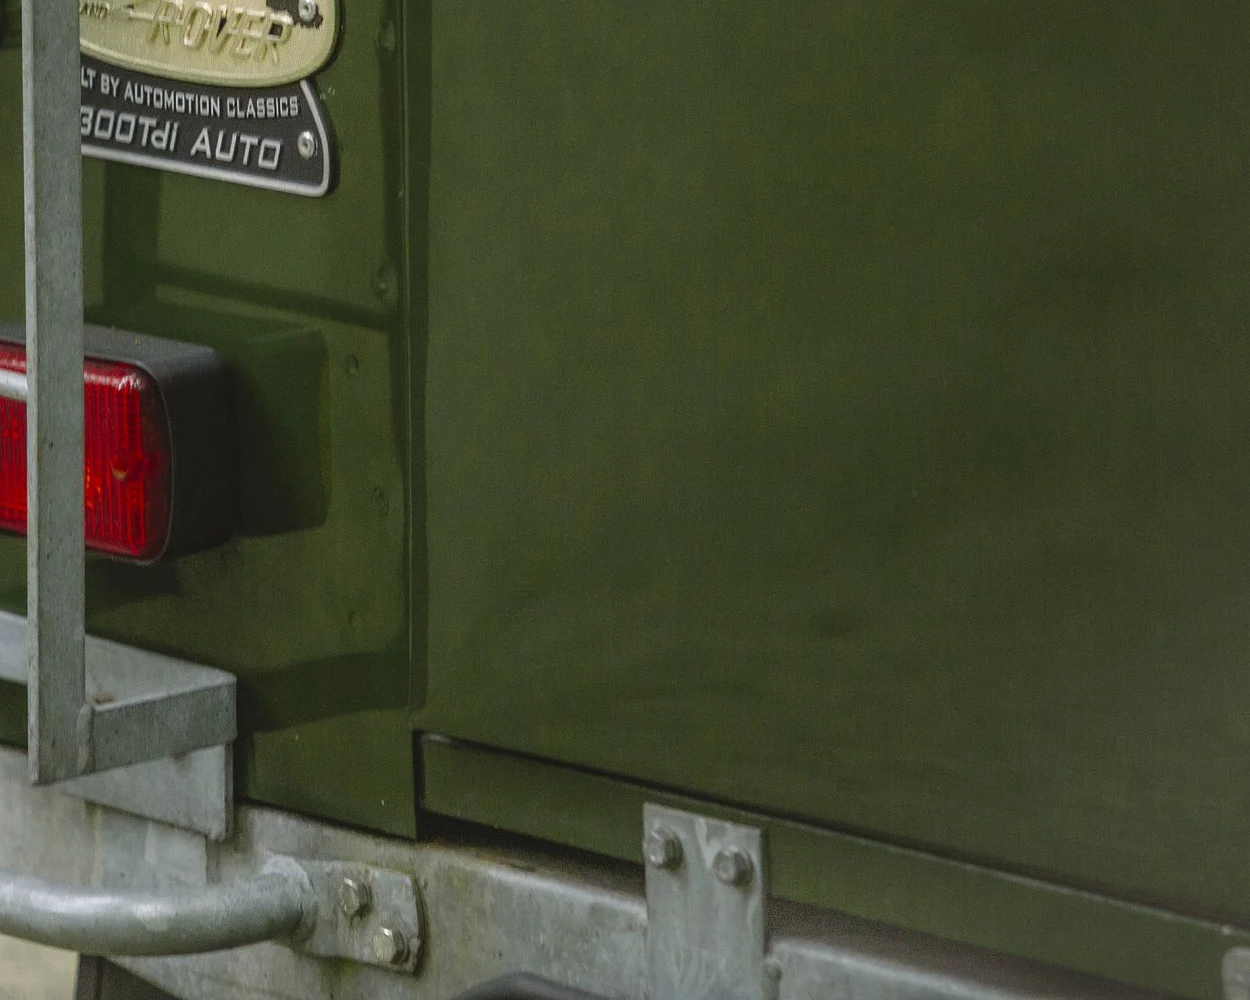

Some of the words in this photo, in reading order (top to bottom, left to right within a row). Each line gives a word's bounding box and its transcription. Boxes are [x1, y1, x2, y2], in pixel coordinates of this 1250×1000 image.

[100, 72, 120, 98] BY
[124, 81, 221, 118] AUTOMOTION
[226, 95, 299, 119] CLASSICS
[189, 127, 283, 171] AUTO
